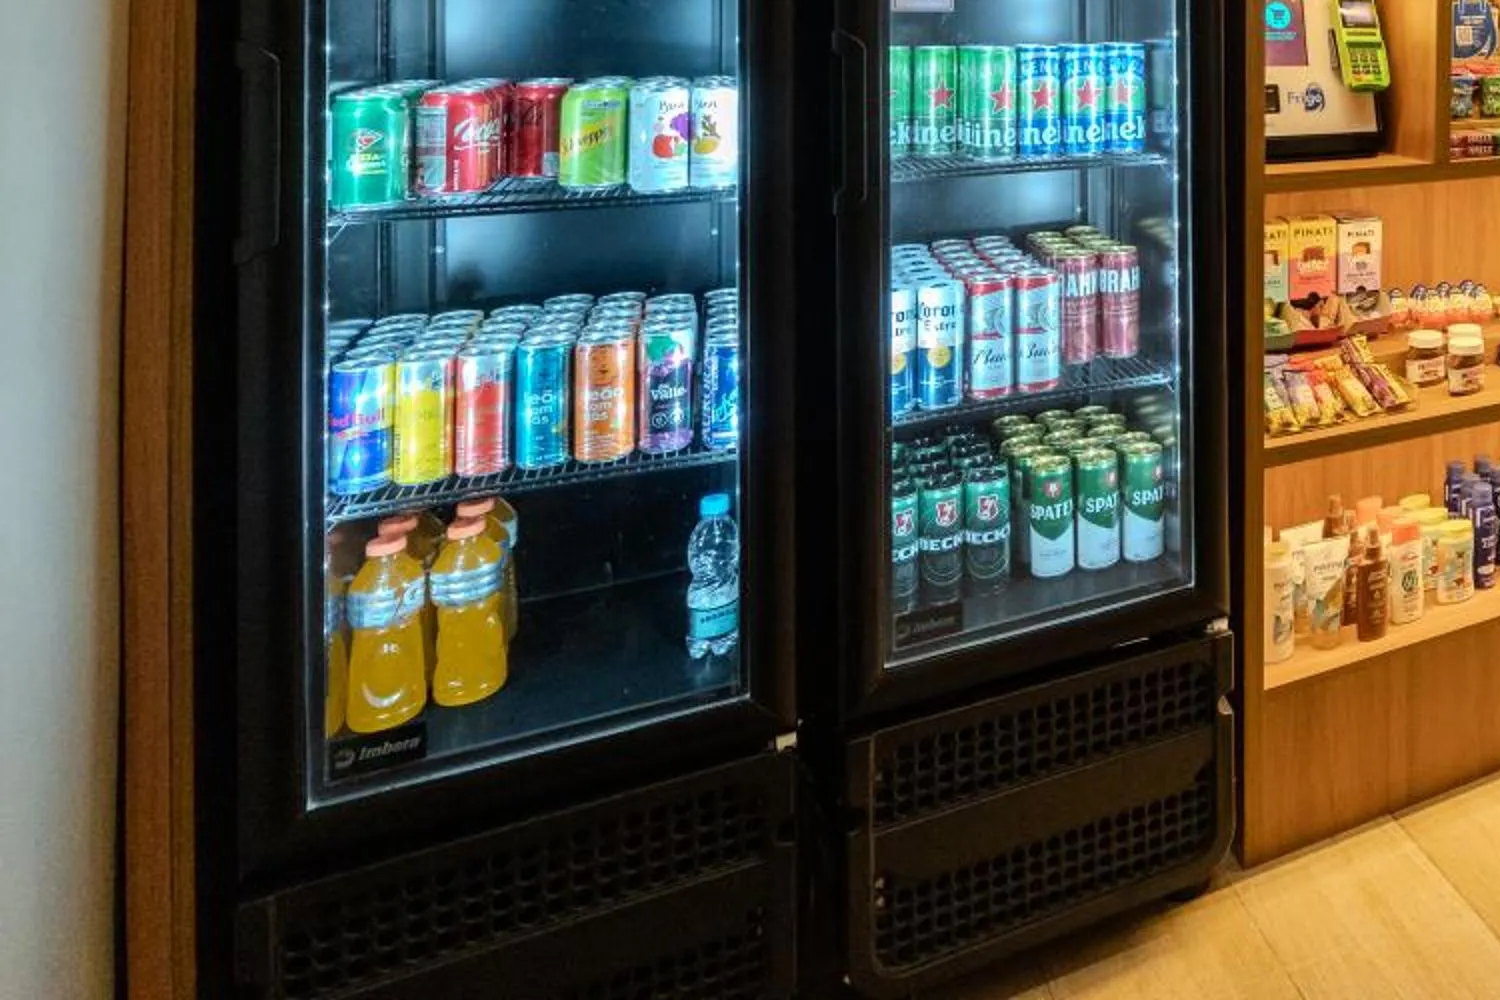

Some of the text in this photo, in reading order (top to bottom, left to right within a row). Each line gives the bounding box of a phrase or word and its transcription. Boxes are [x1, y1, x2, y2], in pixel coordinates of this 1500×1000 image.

[1086, 493, 1118, 514] SPAT
[1132, 485, 1164, 506] SPAT
[1031, 499, 1073, 520] SPATE
